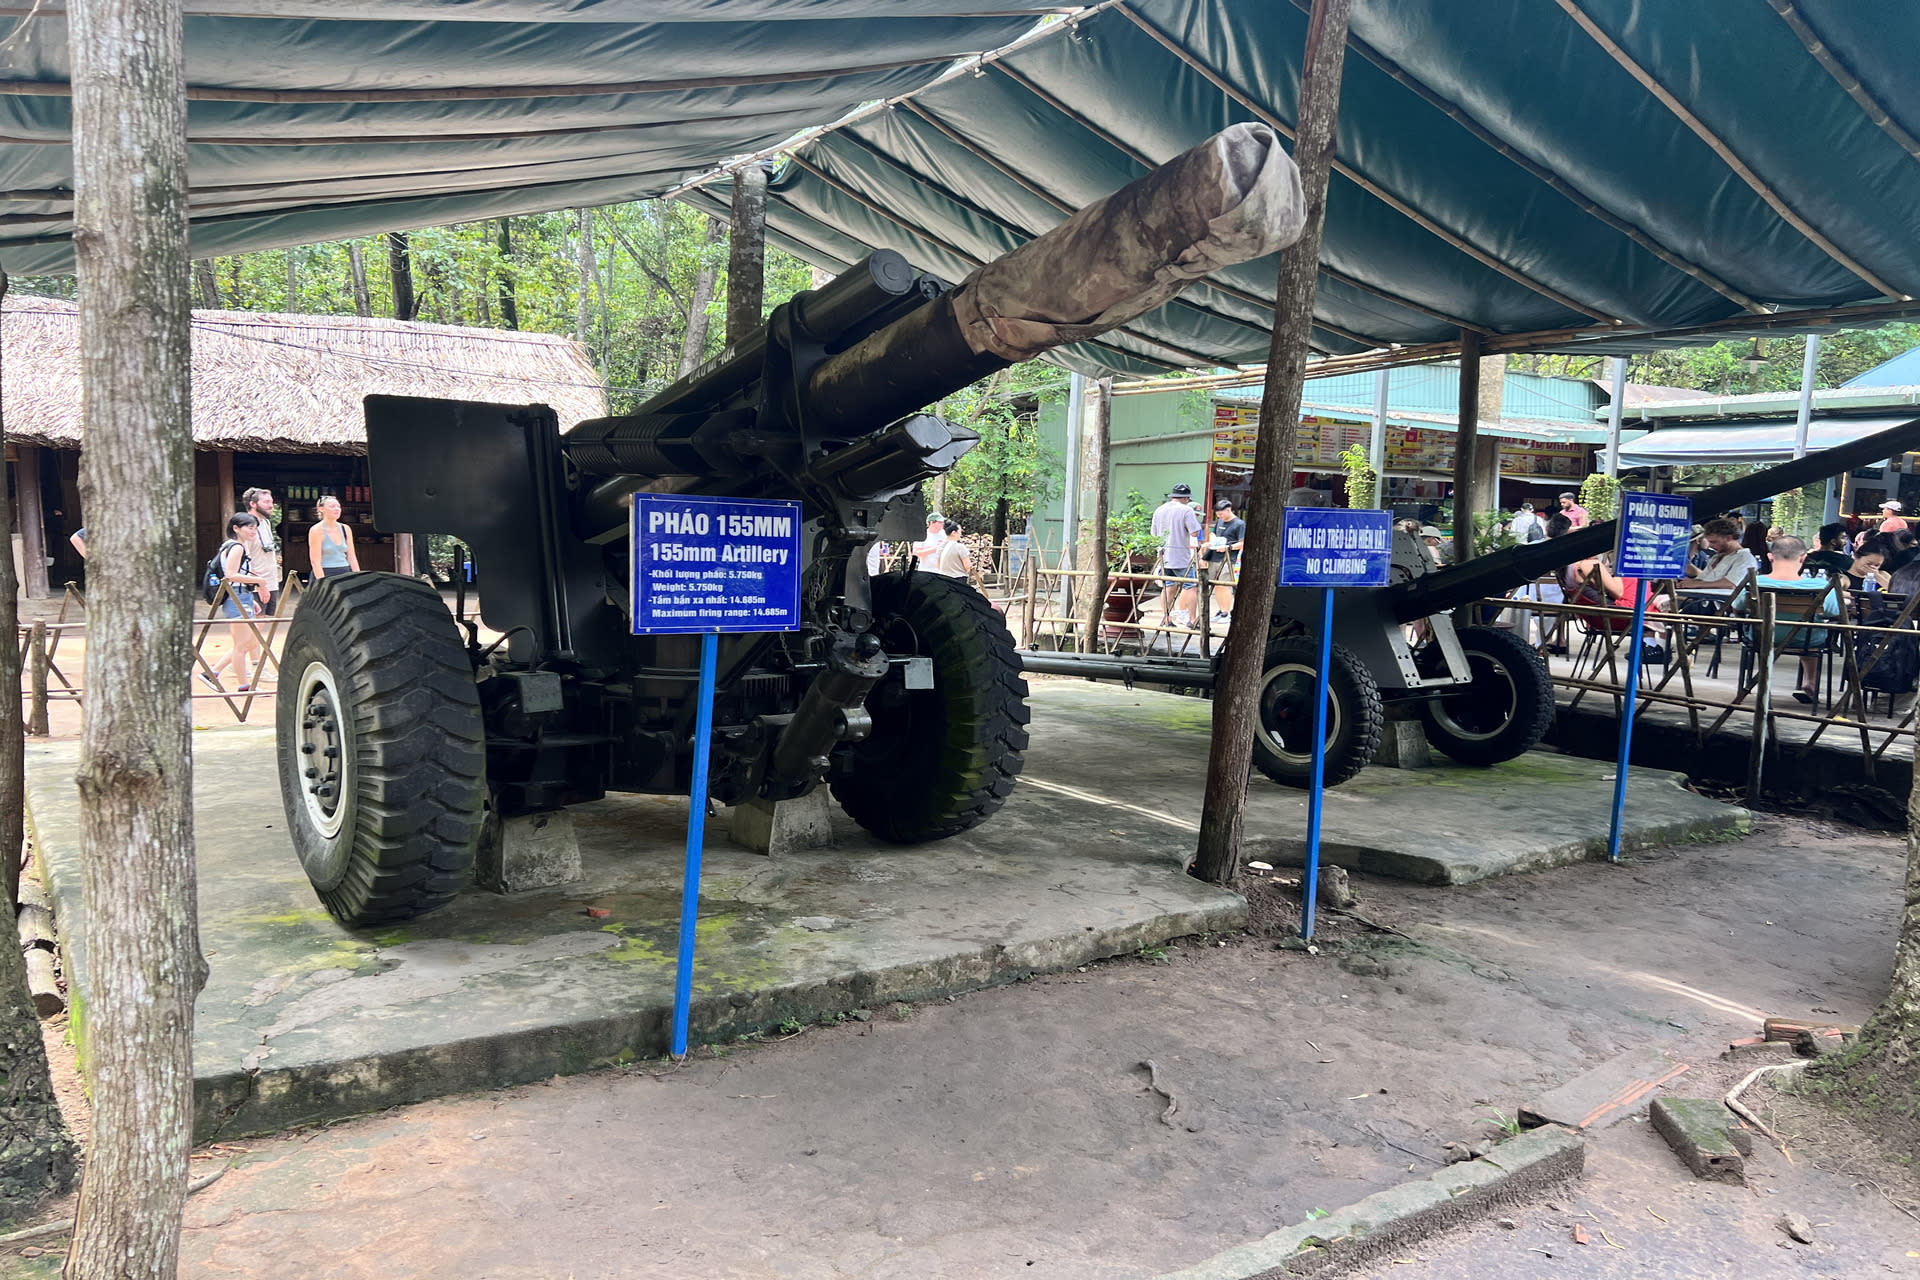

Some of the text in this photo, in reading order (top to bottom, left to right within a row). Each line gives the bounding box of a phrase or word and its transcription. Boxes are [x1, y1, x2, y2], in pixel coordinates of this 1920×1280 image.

[1628, 501, 1688, 519] PHÁO 85MM
[649, 508, 791, 538] PHÁO 155MM
[1655, 523, 1685, 537] Artillery
[1287, 523, 1312, 549] KHÔNG
[1313, 528, 1326, 549] LEO
[1327, 524, 1344, 549] TRÈO
[1344, 524, 1358, 550] LÊN
[650, 543, 788, 565] 155mm Artillery
[1306, 558, 1367, 575] NO CLIMBING
[702, 570, 727, 580] pháo:
[728, 570, 762, 580] 5.750kg
[652, 583, 723, 592] Weight: 5.750kg
[729, 595, 766, 604] 14.685m
[652, 608, 788, 618] Maximum firing range: 14.685m
